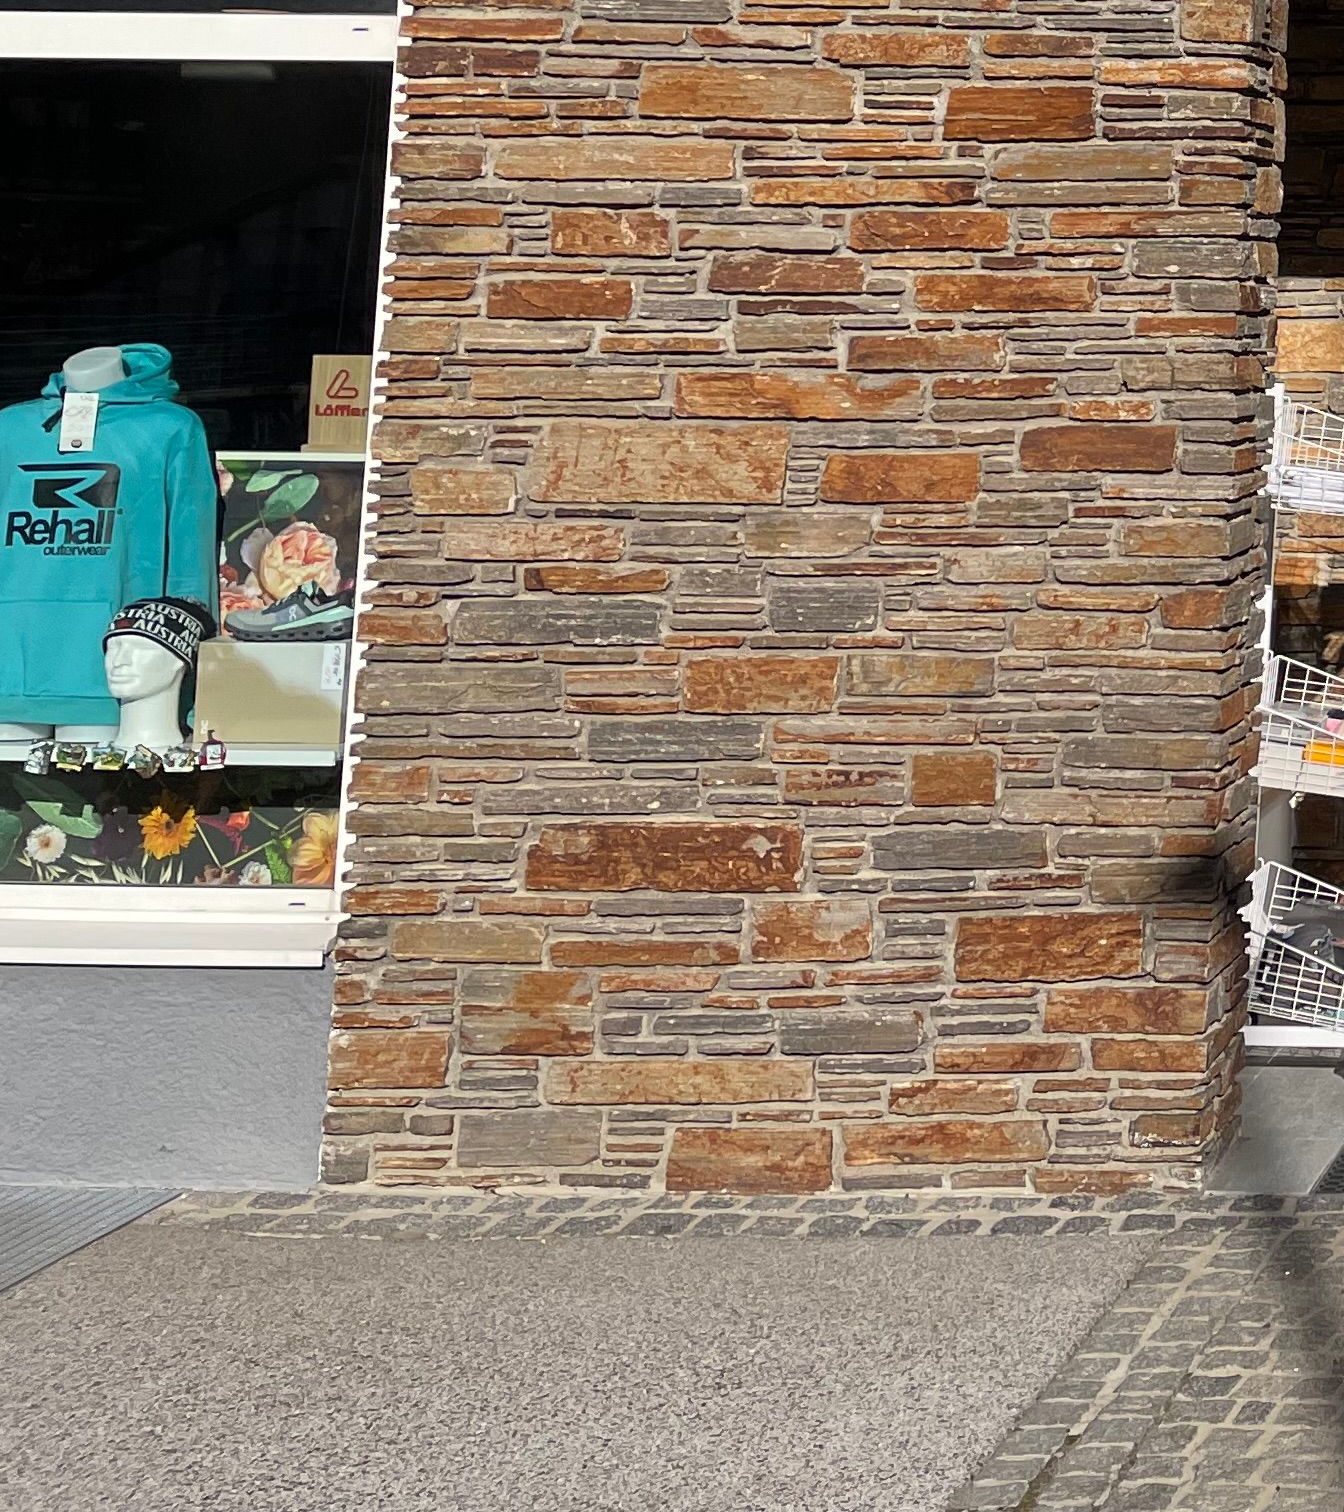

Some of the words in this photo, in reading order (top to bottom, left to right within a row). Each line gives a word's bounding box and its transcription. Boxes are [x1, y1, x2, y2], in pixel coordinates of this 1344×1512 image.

[5, 509, 116, 547] Rehall
[43, 546, 111, 556] outerwear
[113, 608, 165, 626] STRIA
[142, 602, 202, 638] AUSTRIA
[132, 619, 194, 659] AUSTRIA
